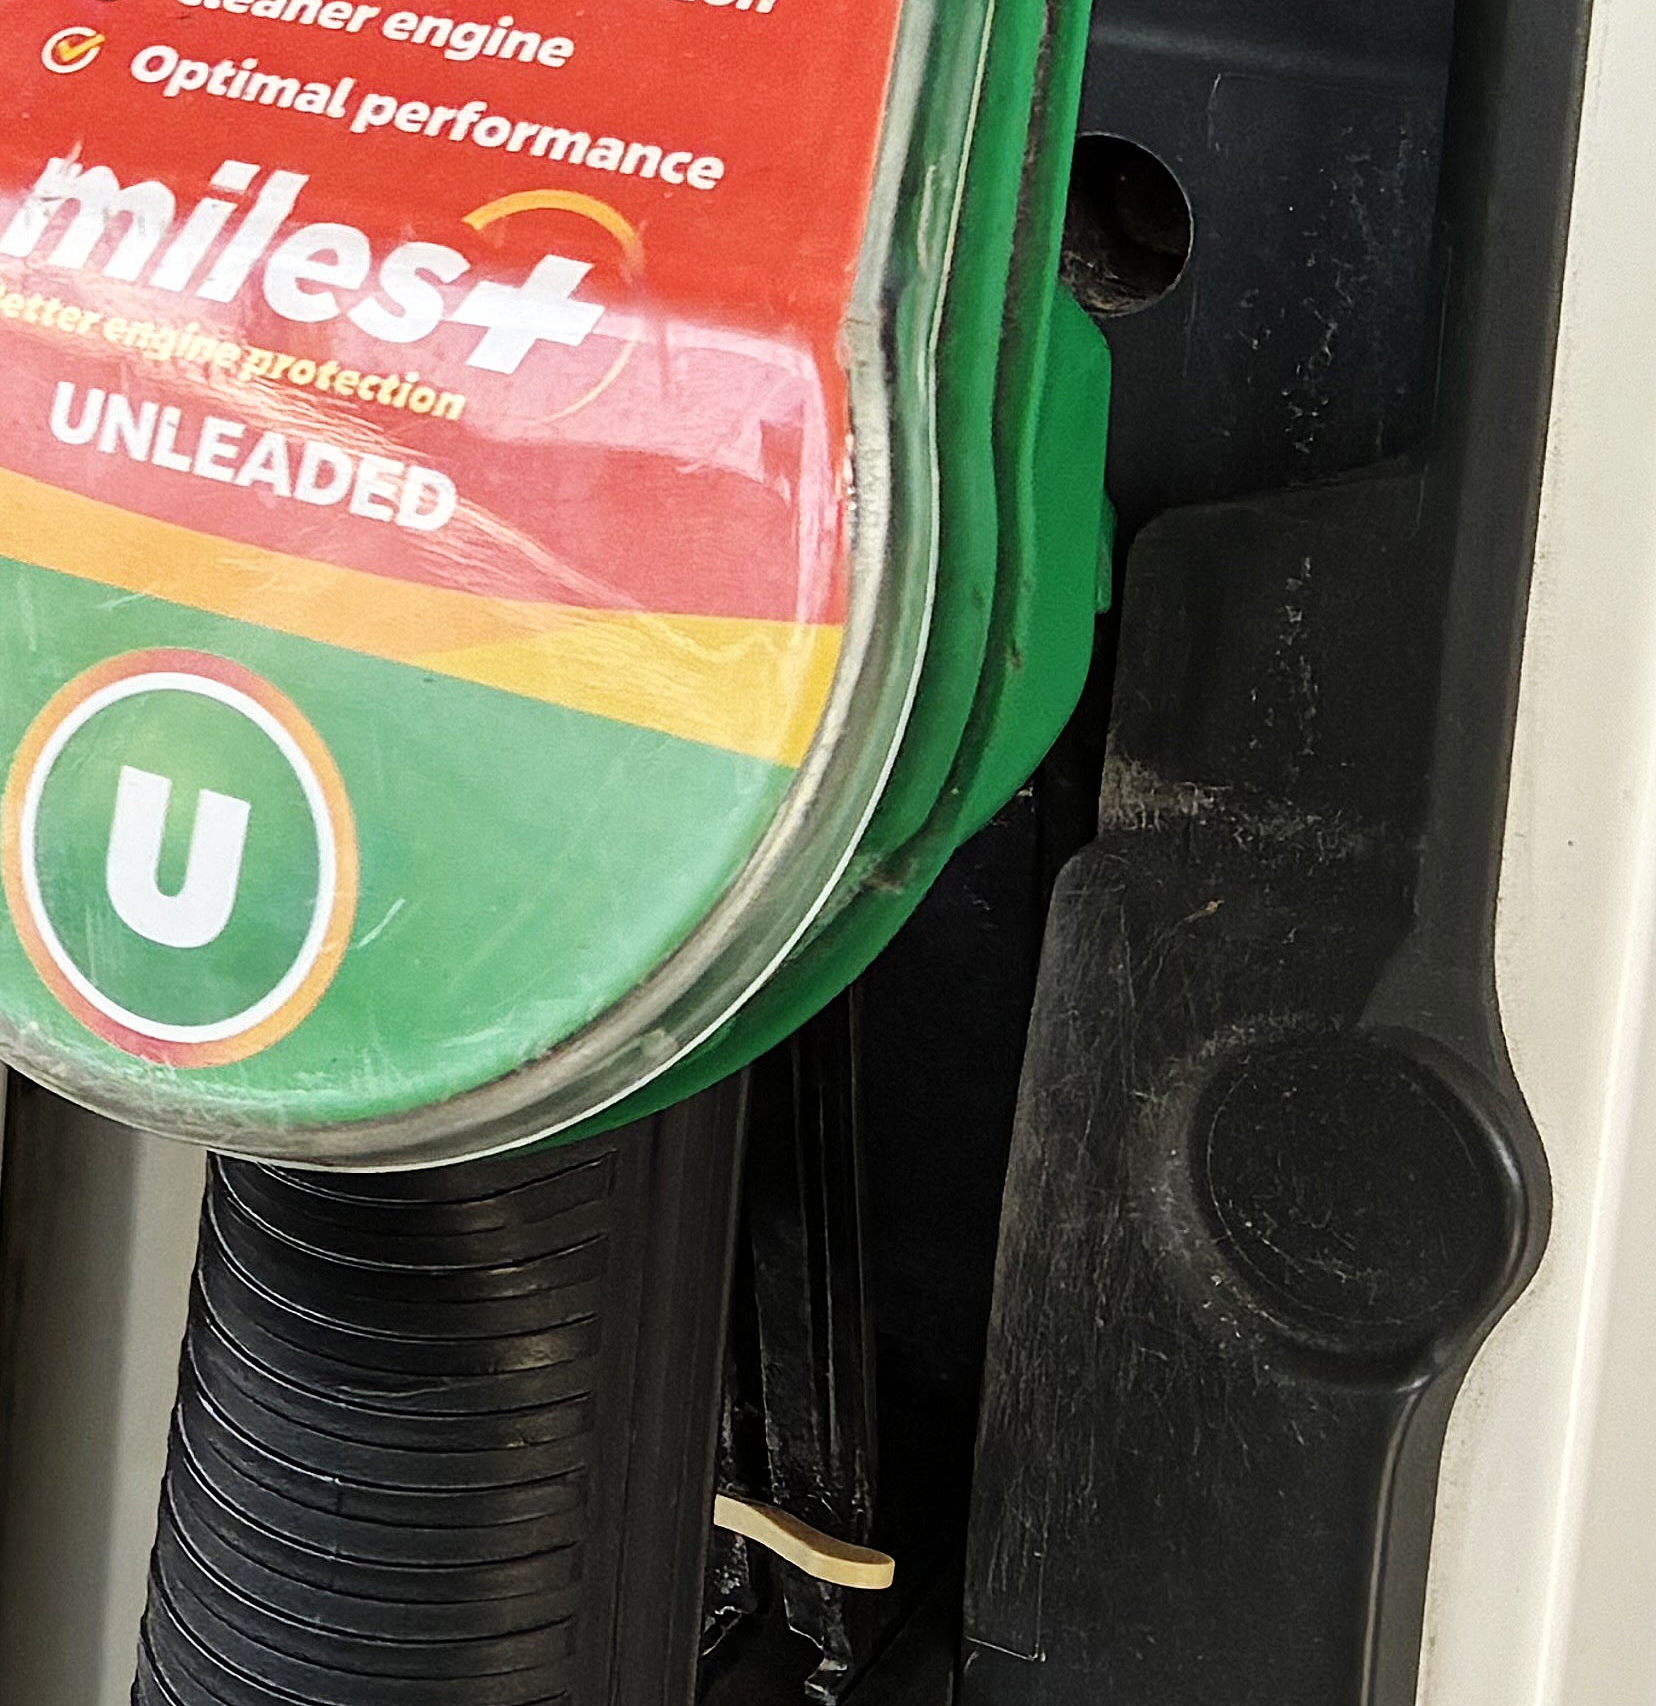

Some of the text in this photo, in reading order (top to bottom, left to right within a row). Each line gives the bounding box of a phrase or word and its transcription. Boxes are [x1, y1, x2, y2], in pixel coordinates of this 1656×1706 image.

[381, 10, 576, 69] engine
[129, 43, 726, 192] Optimal performance
[102, 306, 241, 372] engine
[239, 342, 468, 422] protection
[49, 380, 458, 533] UNLEADED
[105, 763, 253, 950] U
